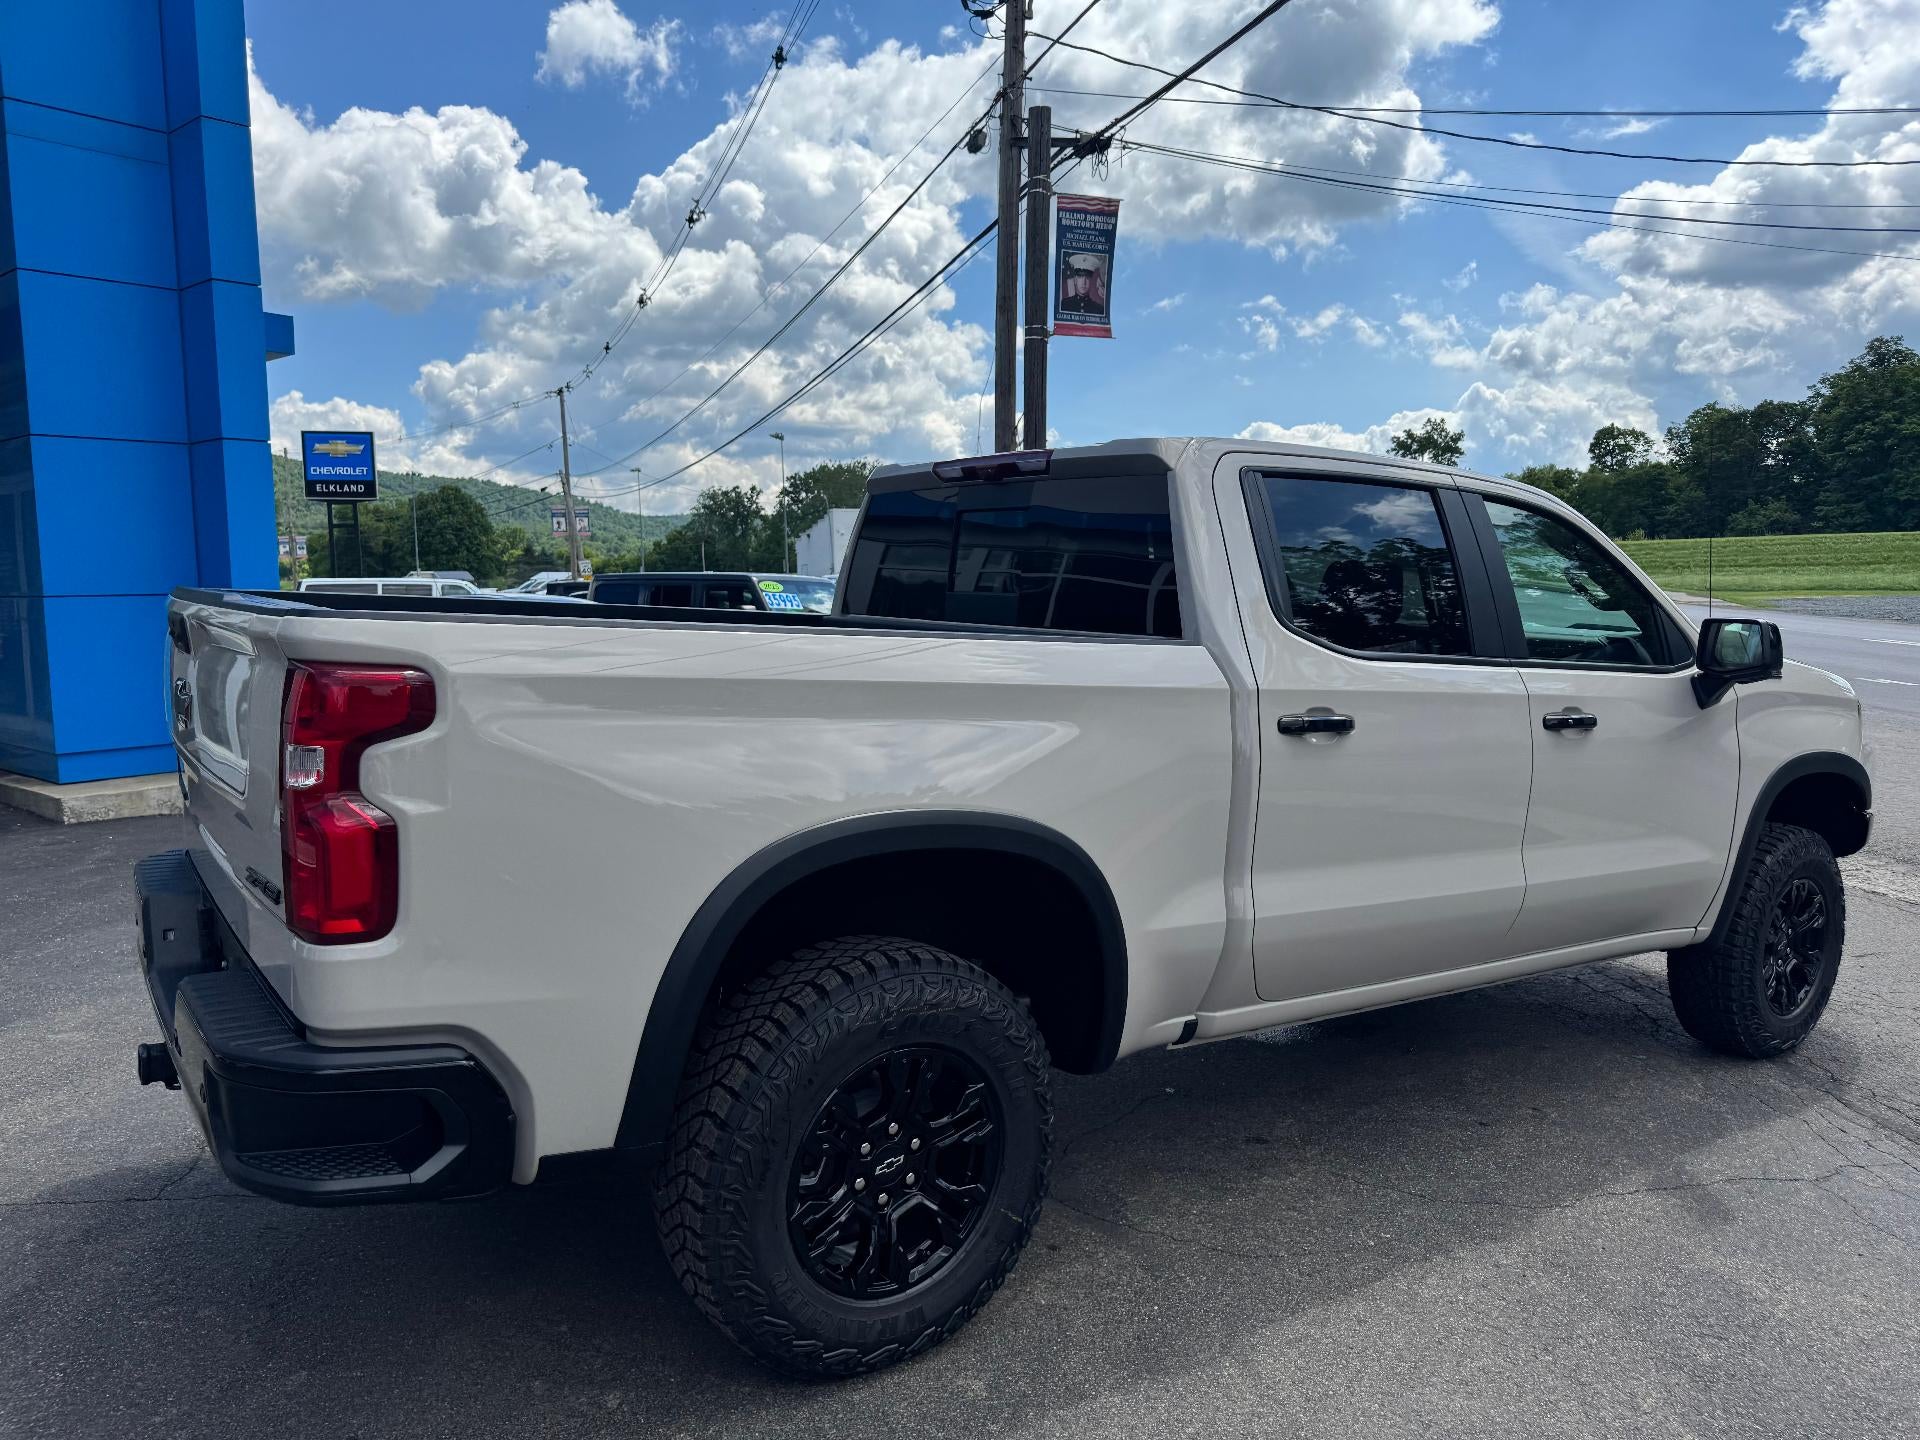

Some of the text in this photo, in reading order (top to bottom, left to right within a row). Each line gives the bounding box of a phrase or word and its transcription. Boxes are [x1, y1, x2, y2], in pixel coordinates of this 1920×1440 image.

[1061, 218, 1113, 230] HOMETOWN HERO
[1087, 214, 1116, 224] BOROUGH
[1072, 241, 1091, 249] MARINE
[310, 466, 368, 475] CHEVROLET
[316, 483, 365, 493] ELKLAND
[764, 592, 800, 608] 35995
